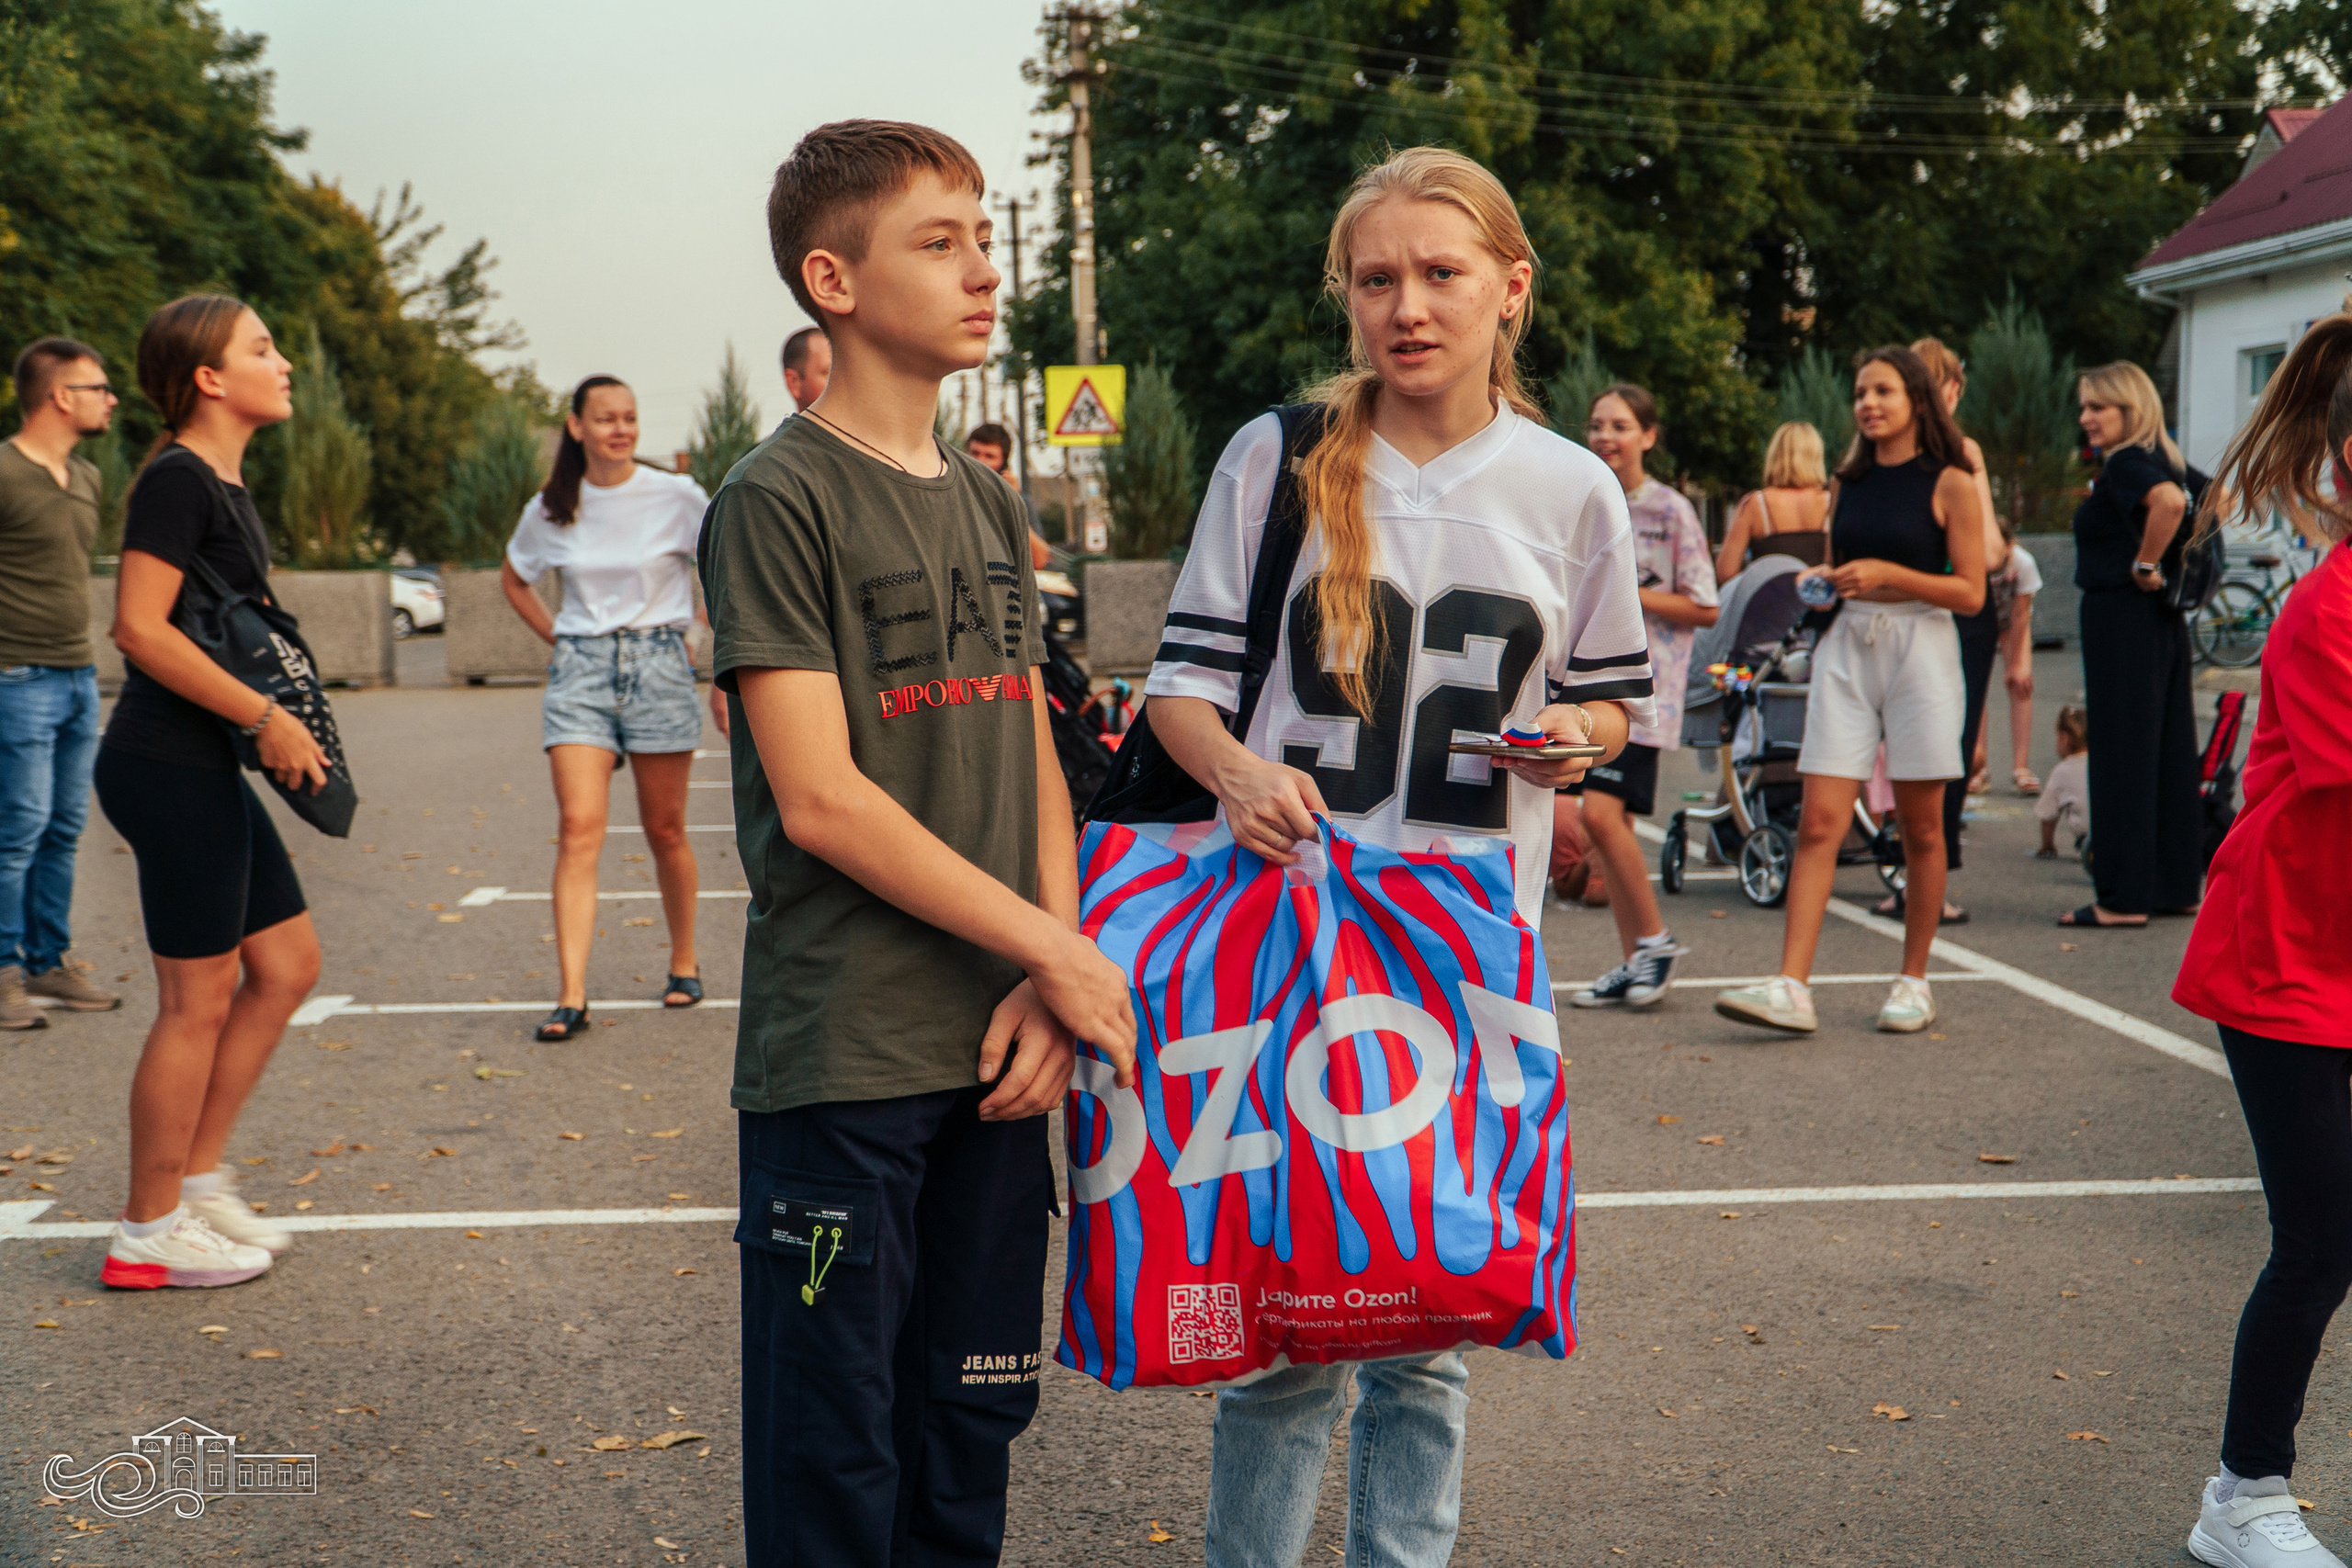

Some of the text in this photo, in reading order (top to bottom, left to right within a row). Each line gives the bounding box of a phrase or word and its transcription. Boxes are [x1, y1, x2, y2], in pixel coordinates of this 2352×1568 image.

[877, 677, 973, 718] EMPORIO
[1278, 571, 1547, 834] 92
[1344, 1286, 1417, 1308] Ozon!
[1349, 1318, 1367, 1326] на
[1372, 1313, 1420, 1325] любой
[1425, 1311, 1493, 1324] праздник
[962, 1355, 1017, 1371] JEANS
[962, 1374, 986, 1384] NEW
